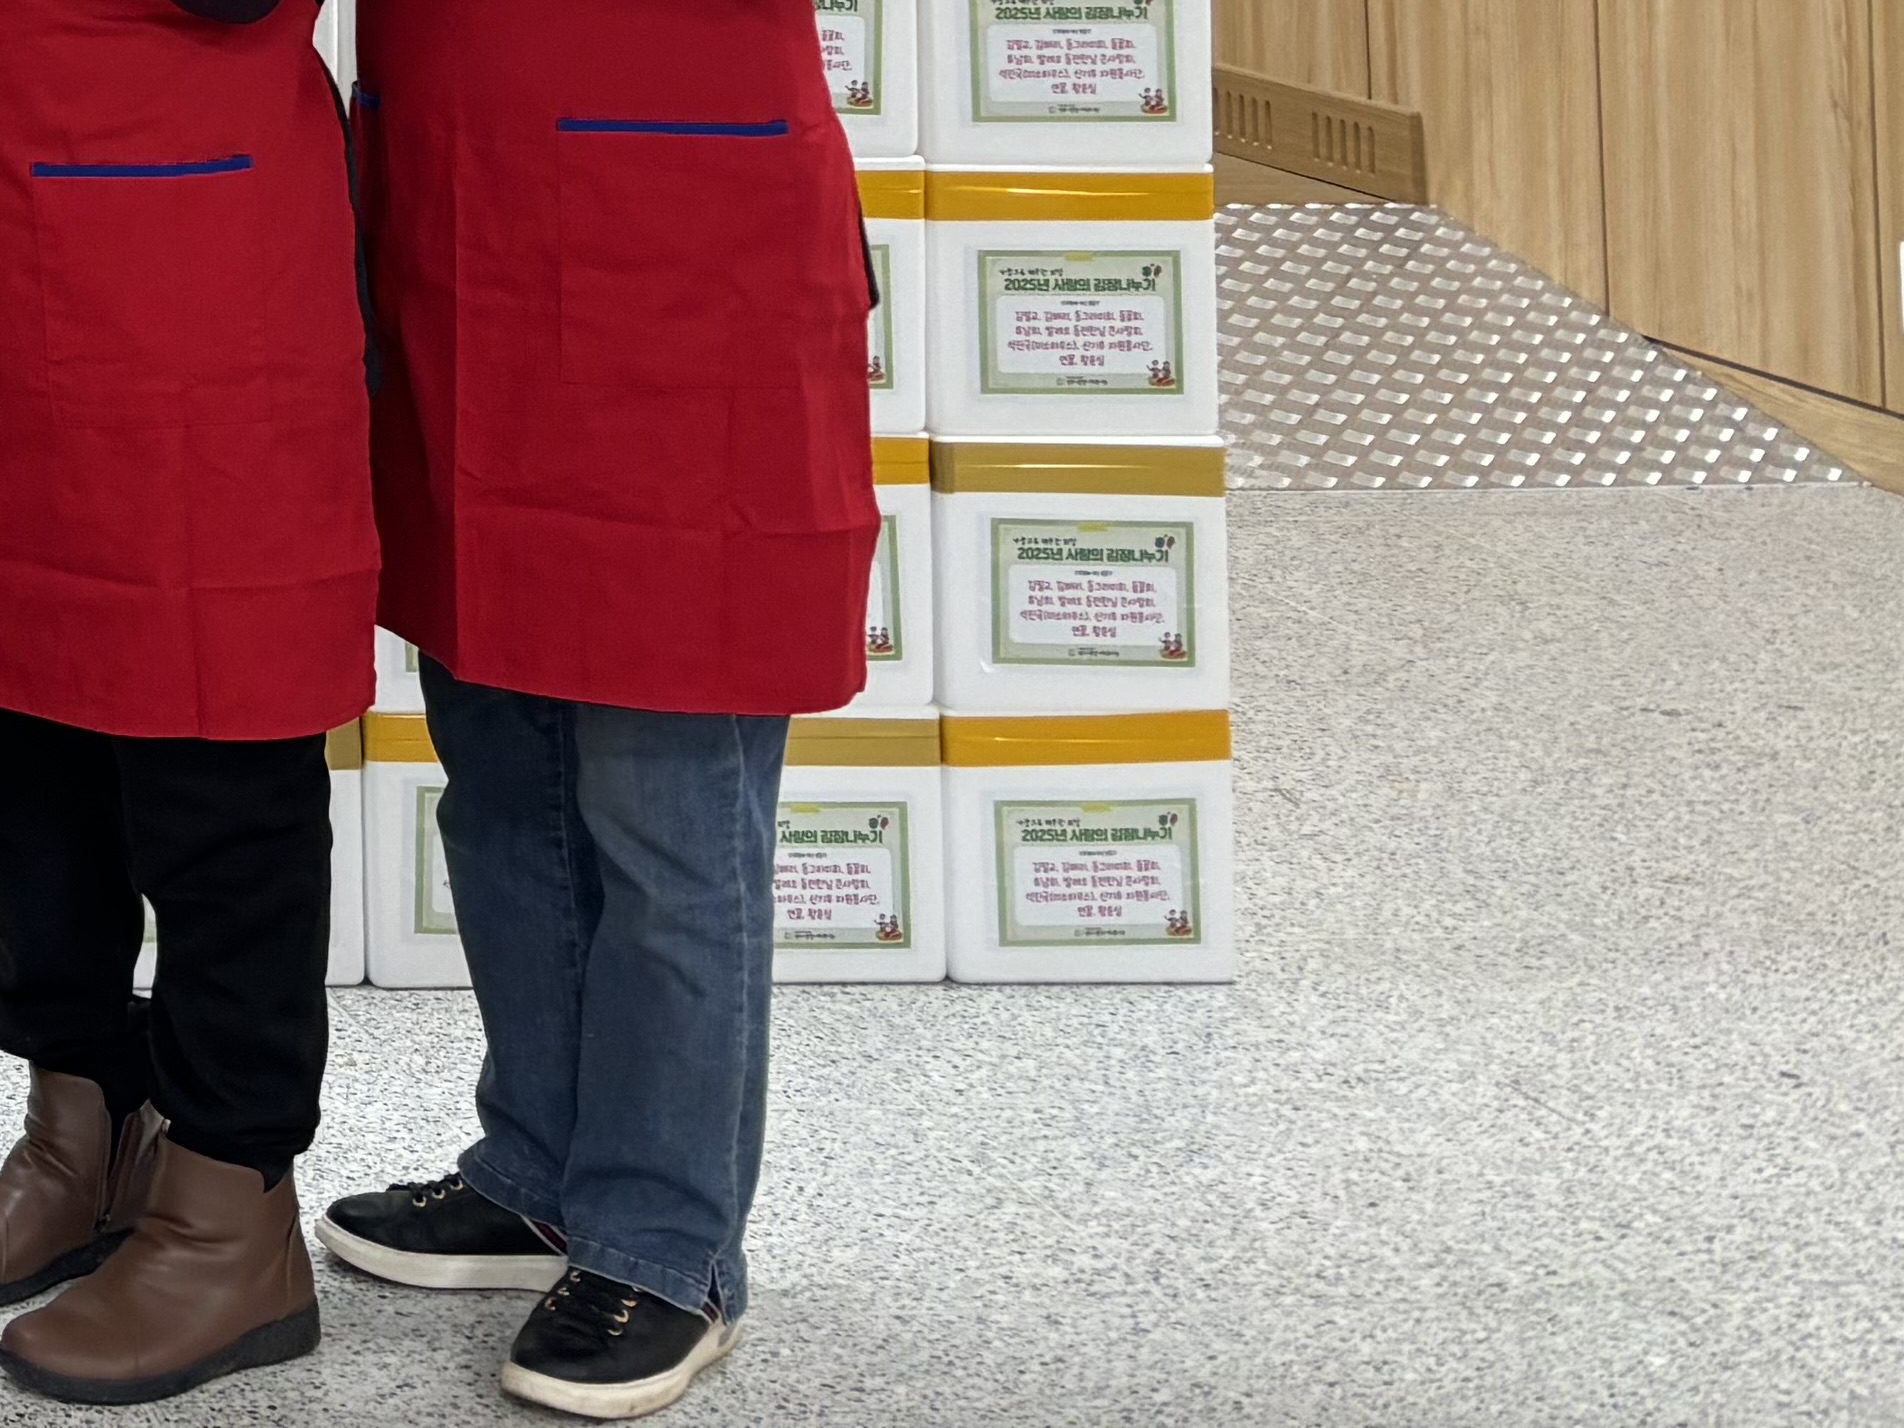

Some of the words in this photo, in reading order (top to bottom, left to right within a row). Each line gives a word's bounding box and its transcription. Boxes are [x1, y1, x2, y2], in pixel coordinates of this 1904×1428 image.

[995, 6, 1041, 21] 2025년
[1003, 277, 1049, 292] 2025년
[1017, 547, 1062, 560] 2025년
[1021, 827, 1067, 843] 2025년
